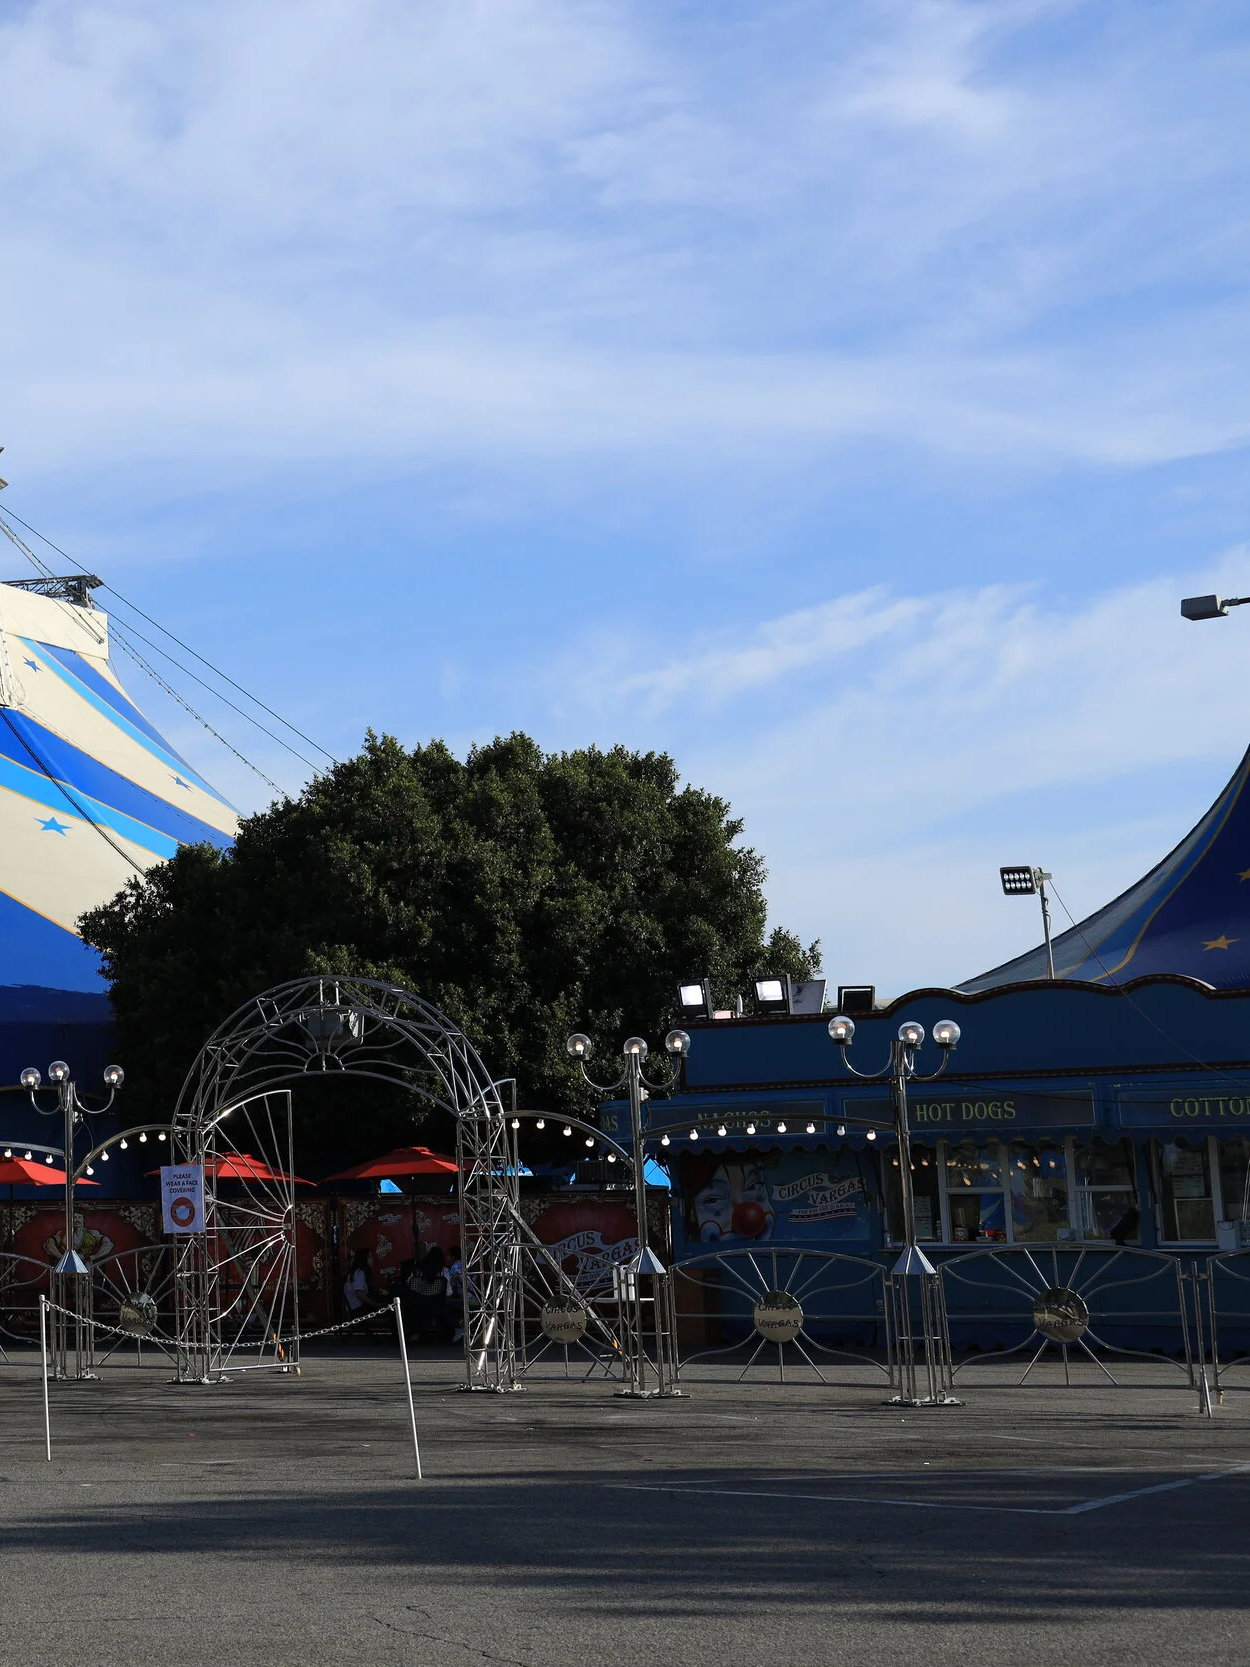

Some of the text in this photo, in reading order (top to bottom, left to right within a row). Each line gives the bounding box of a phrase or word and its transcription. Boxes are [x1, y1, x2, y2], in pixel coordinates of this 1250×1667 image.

[915, 1101, 1016, 1121] HOT DOGS
[1170, 1097, 1250, 1117] COTTO
[779, 1174, 823, 1199] CIRCUS
[811, 1178, 865, 1204] VARGAS
[545, 1305, 578, 1314] CIRCUS
[545, 1321, 583, 1331] VARGAS
[758, 1320, 799, 1329] VARGAS
